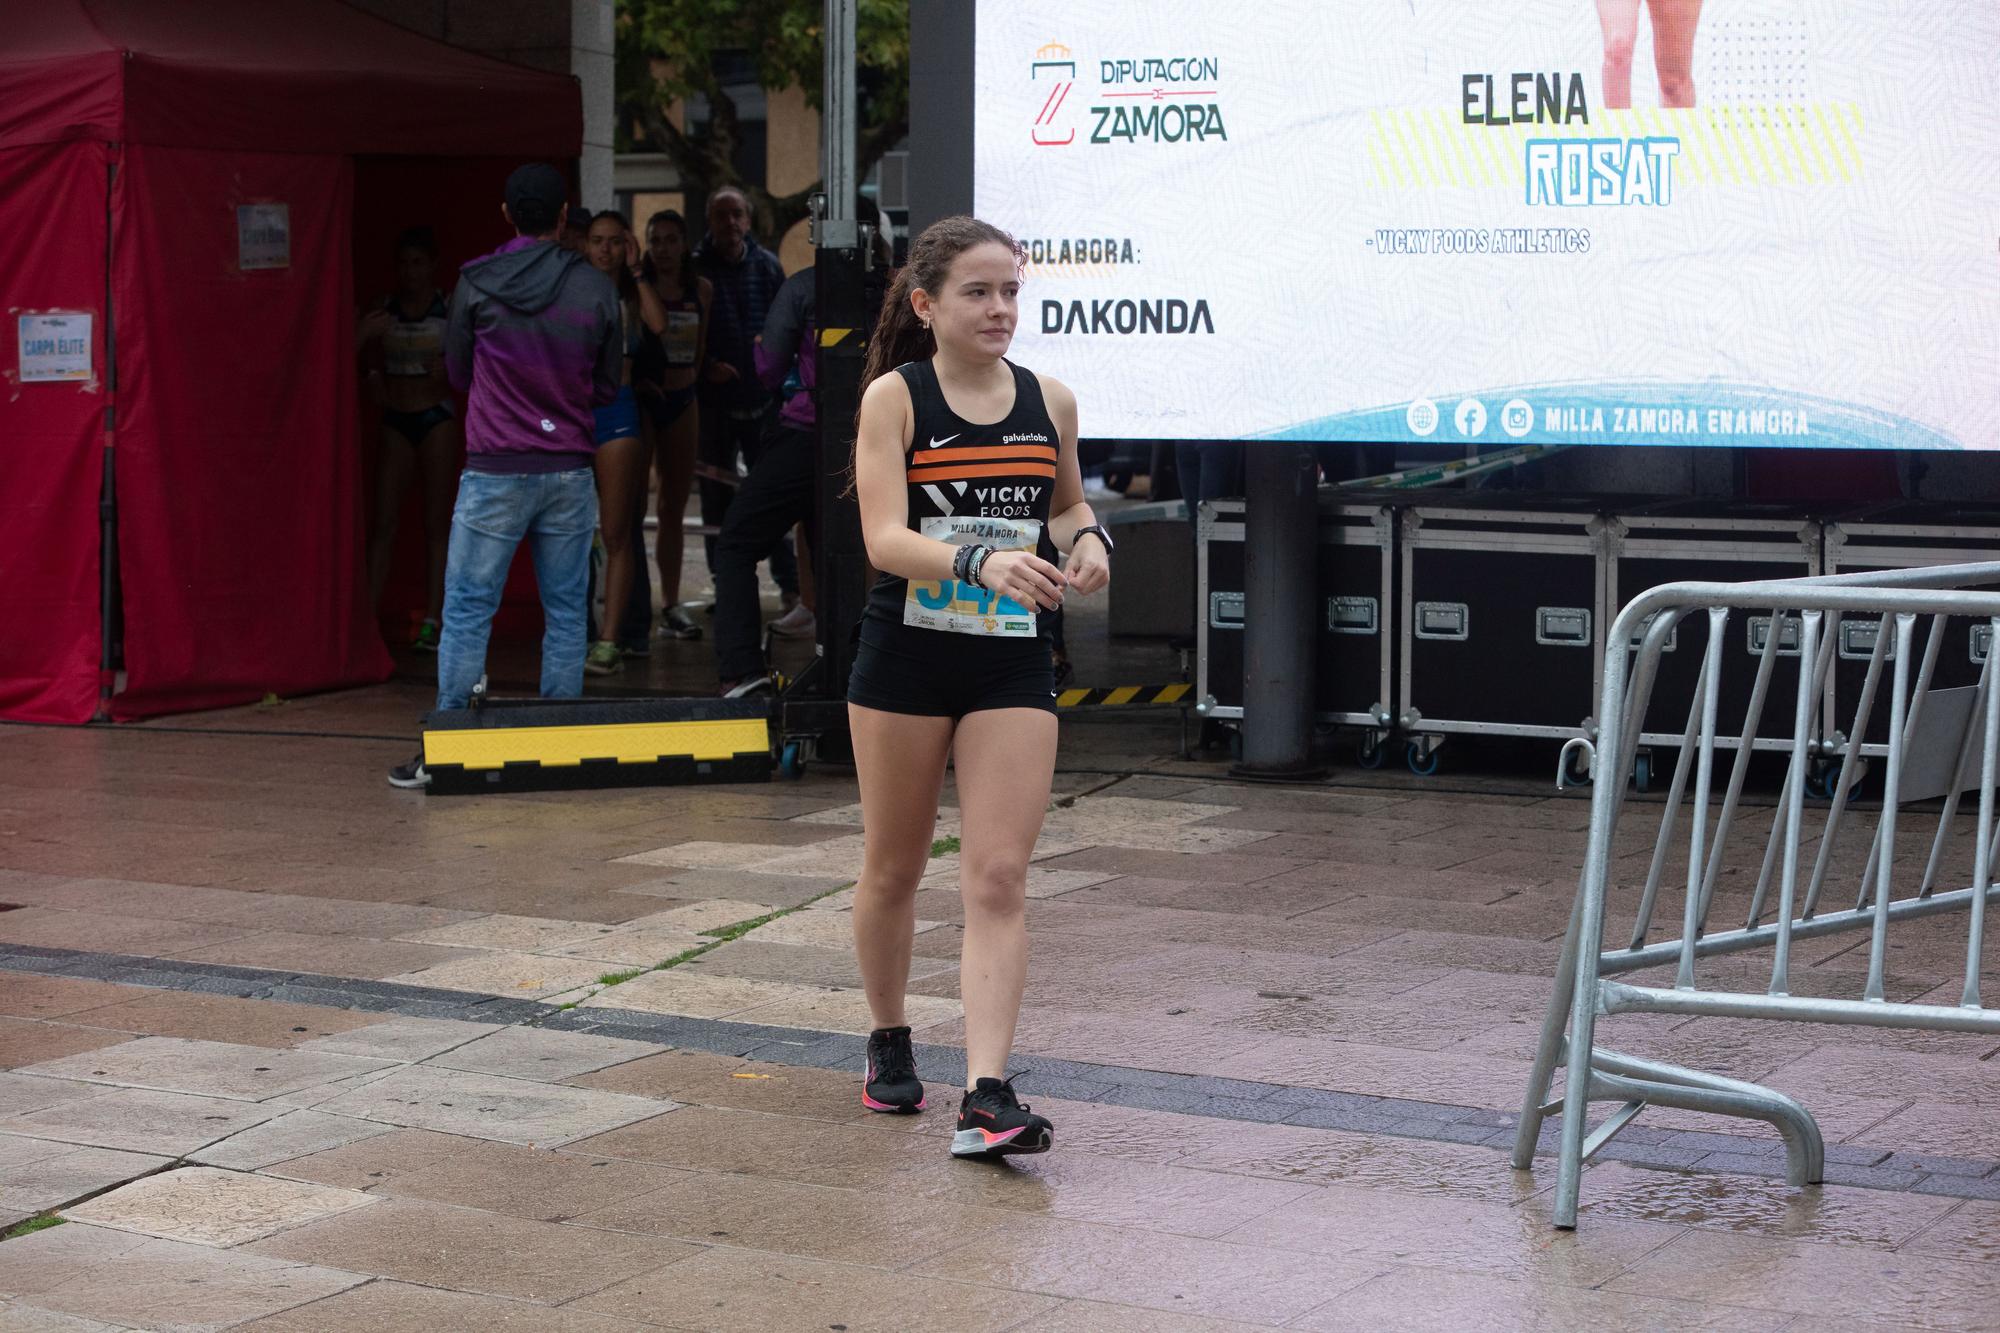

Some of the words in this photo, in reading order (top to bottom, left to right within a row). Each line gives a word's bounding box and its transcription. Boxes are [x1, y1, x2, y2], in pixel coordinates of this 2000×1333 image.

[1462, 73, 1589, 126] ELENA
[1091, 104, 1227, 144] ZAMORA
[1525, 136, 1680, 206] ROSAT
[1376, 229, 1430, 253] VICKY
[1432, 229, 1489, 253] FOODS
[1491, 228, 1590, 253] ATHLETICS
[1041, 299, 1215, 334] DAKONDA
[1545, 407, 1604, 432] MILLA
[1613, 408, 1699, 433] ZAMORA
[1708, 409, 1809, 435] ENAMORA
[974, 486, 1042, 503] VICKY
[980, 505, 1030, 518] FOODS
